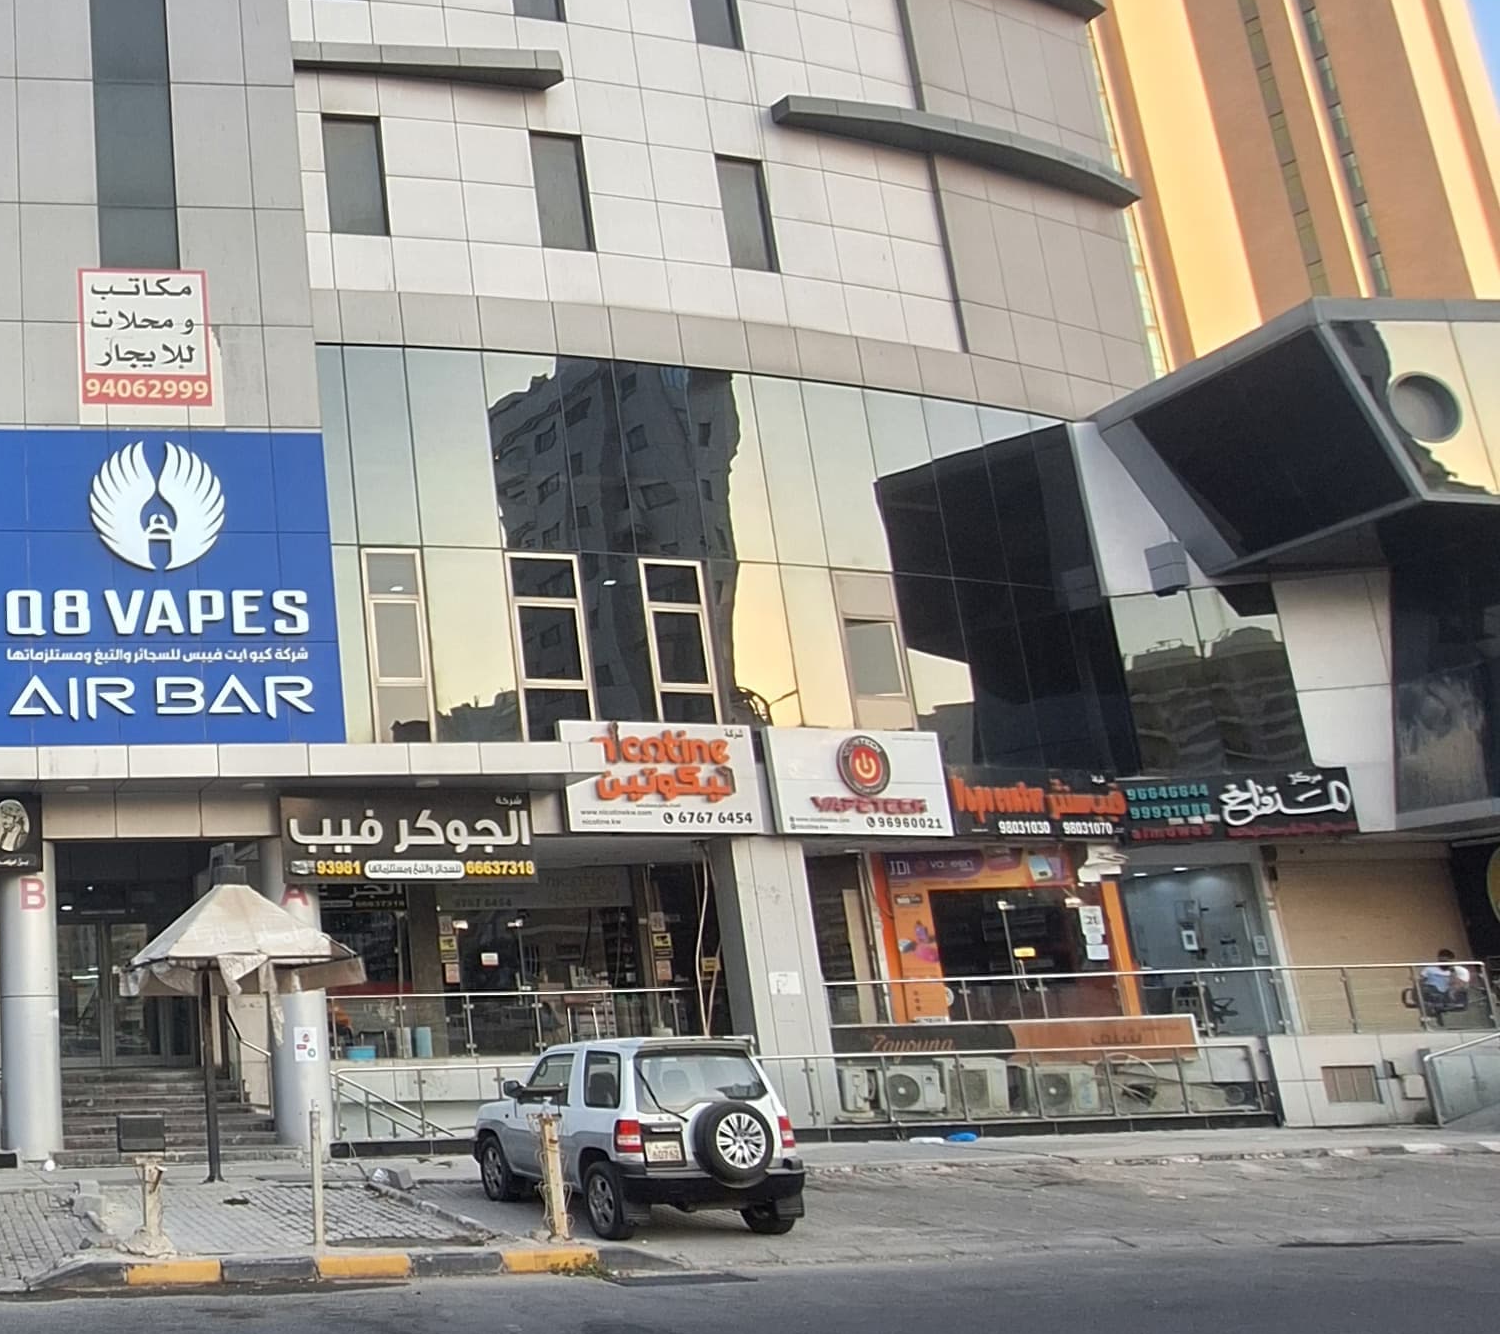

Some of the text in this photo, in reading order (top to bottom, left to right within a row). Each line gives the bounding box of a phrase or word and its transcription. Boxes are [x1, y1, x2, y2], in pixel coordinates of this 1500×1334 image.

[90, 277, 192, 299] مكاتب
[90, 309, 174, 332] محلات
[85, 378, 209, 400] 94062999
[6, 589, 310, 637] Q8 VAPES
[133, 647, 181, 663] للسجائر
[275, 647, 308, 660] شركة
[9, 674, 315, 720] AIR BAR
[495, 796, 522, 806] شركة
[678, 811, 753, 824] 6767 6454
[878, 817, 943, 829] 96960021
[289, 809, 531, 854] الجوكر فيب
[465, 860, 535, 876] 66637318
[20, 877, 46, 910] B
[281, 883, 309, 906] A
